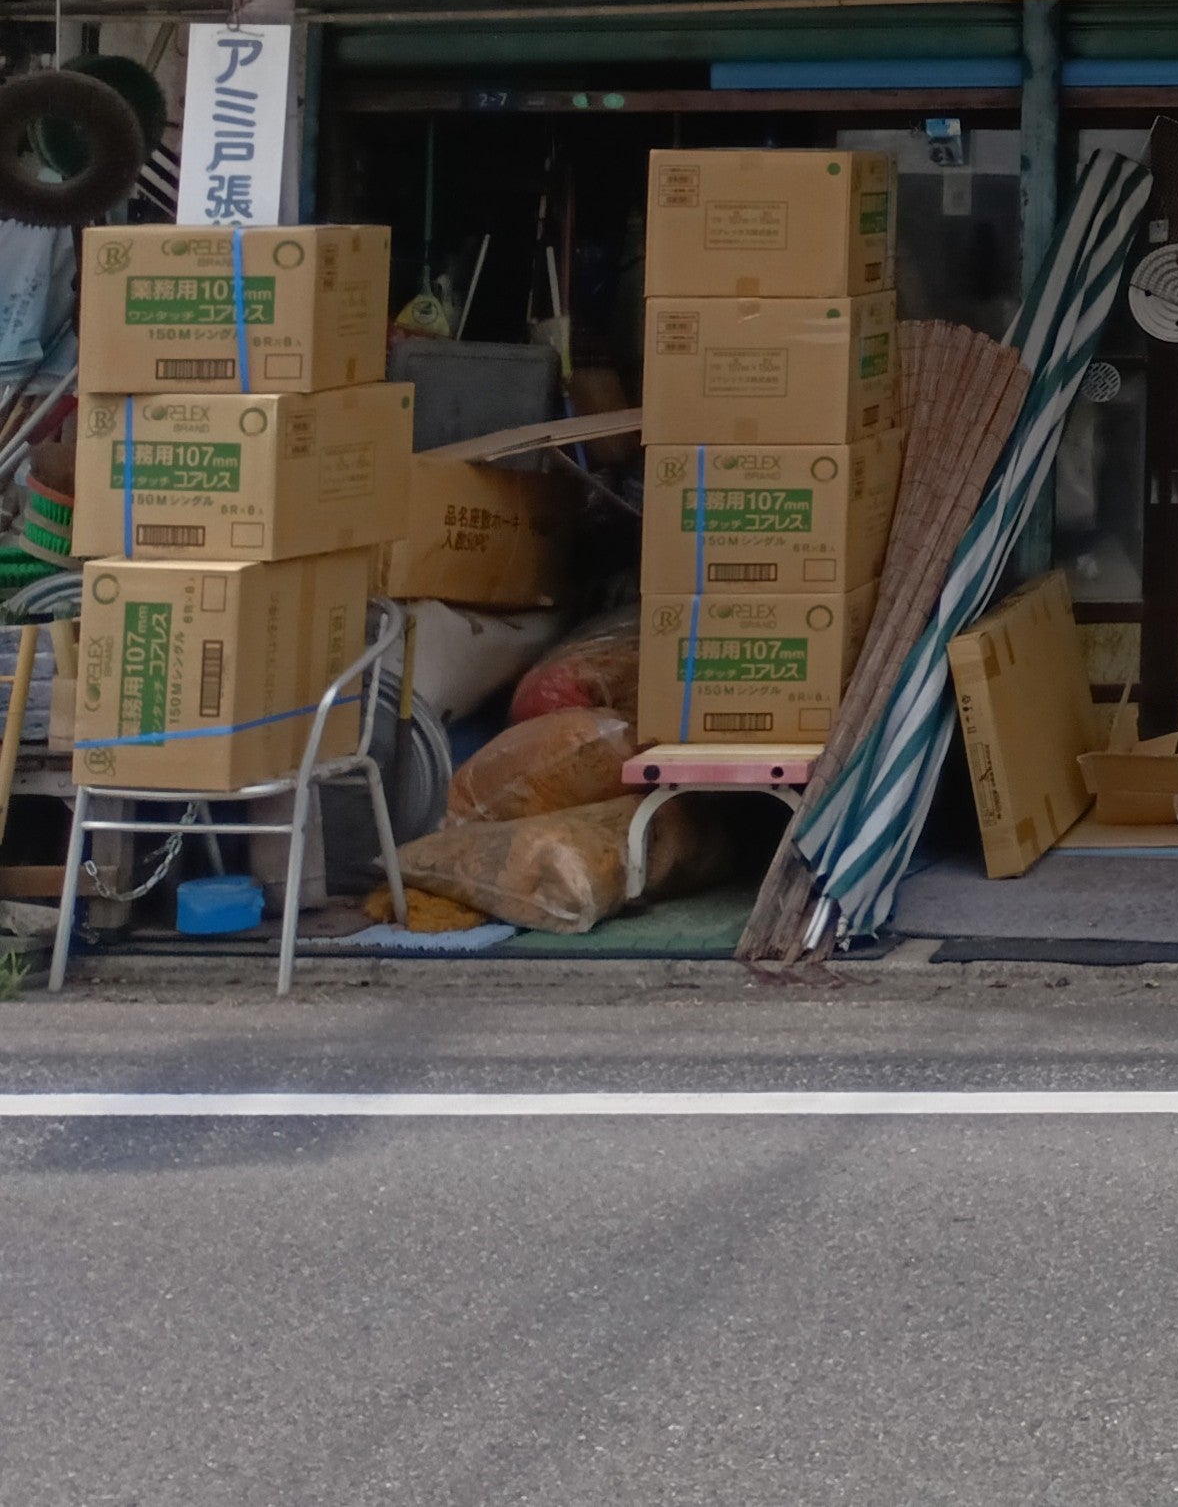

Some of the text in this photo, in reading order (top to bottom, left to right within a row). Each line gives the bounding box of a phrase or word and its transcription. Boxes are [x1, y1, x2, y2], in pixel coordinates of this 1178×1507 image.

[205, 38, 263, 226] アミ戸張
[196, 257, 233, 268] BRAN
[112, 471, 232, 489] ワタッチ コアレス
[745, 514, 804, 530] コアレス
[149, 613, 168, 742] ンタッチ コアレス
[740, 663, 800, 679] コアレス
